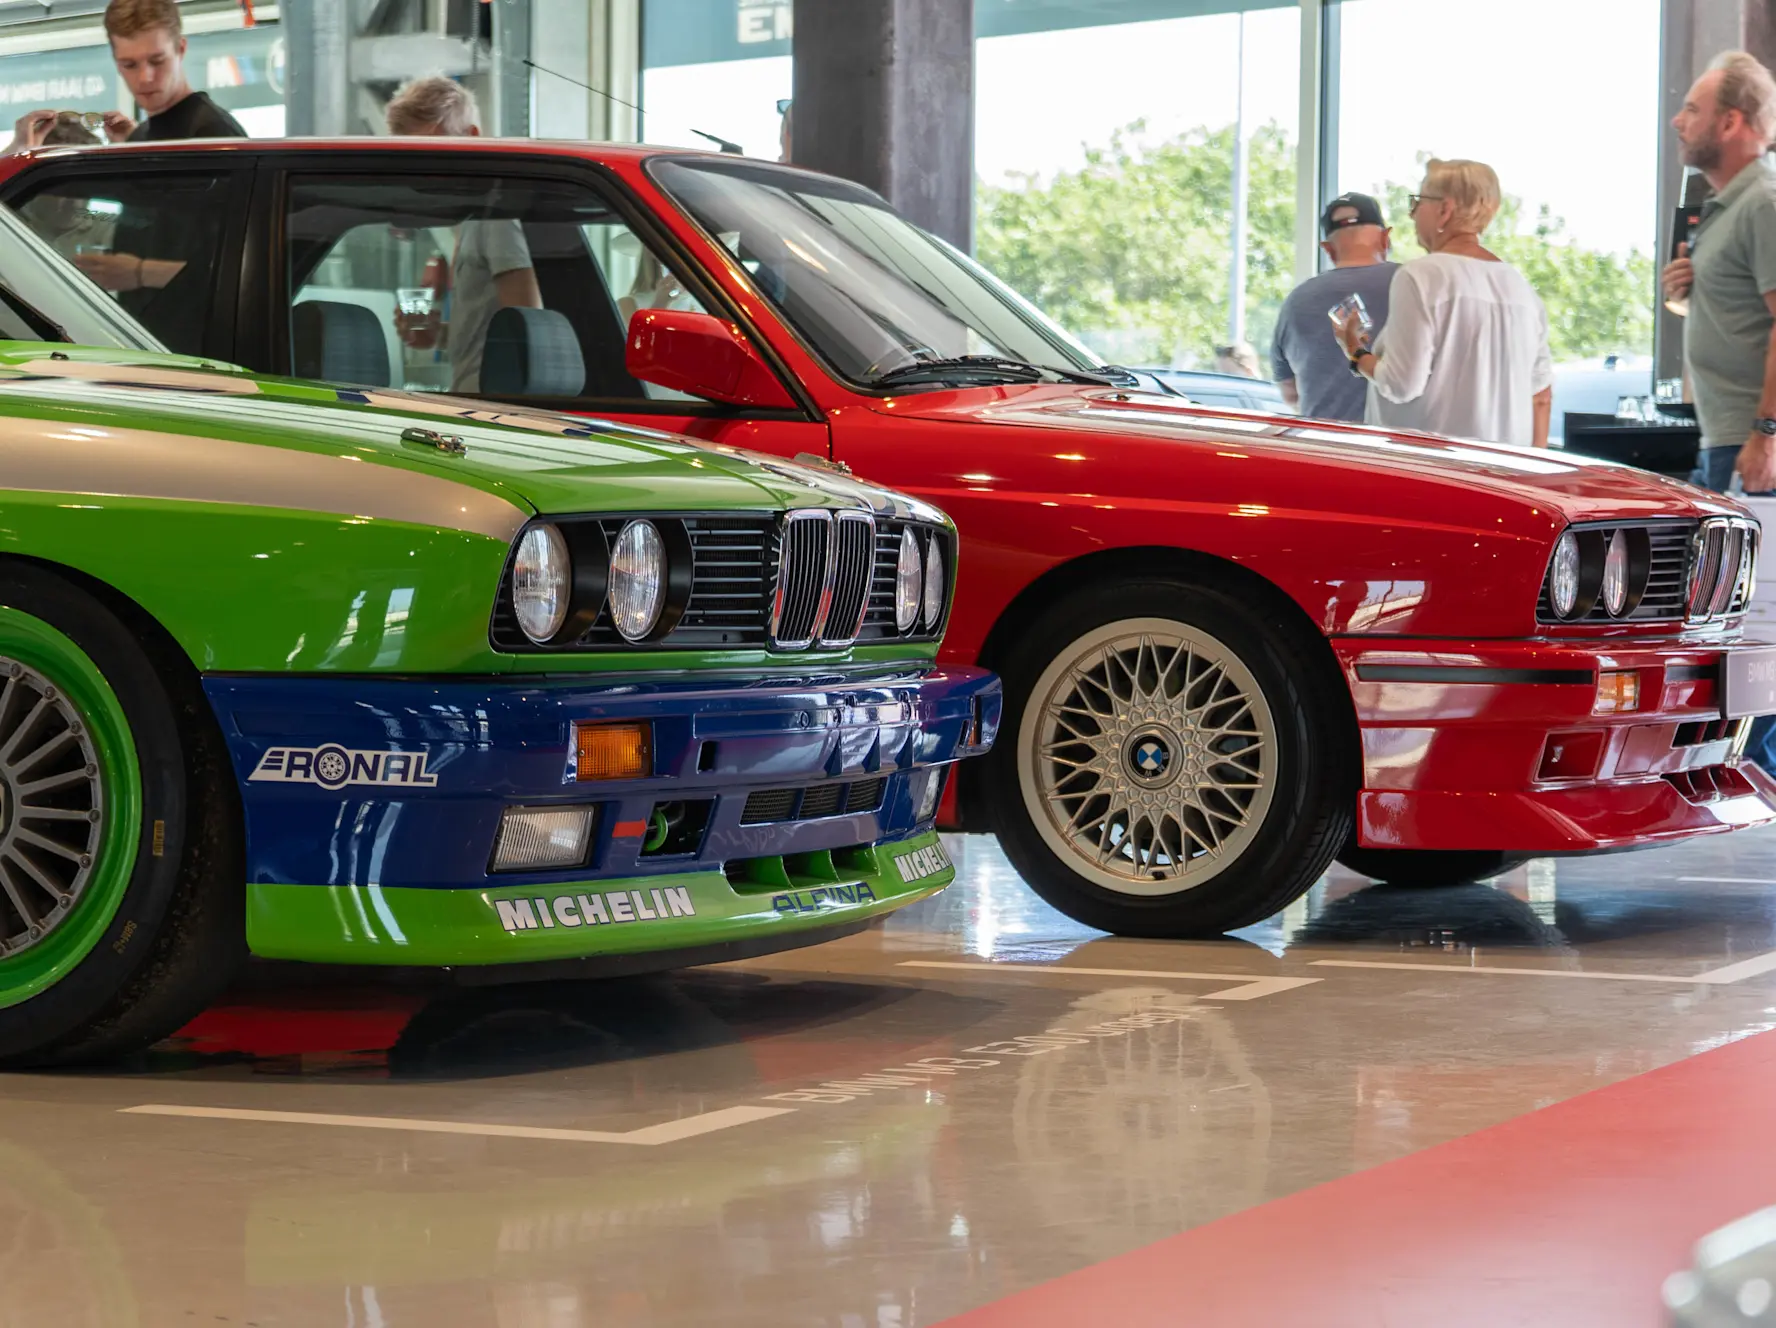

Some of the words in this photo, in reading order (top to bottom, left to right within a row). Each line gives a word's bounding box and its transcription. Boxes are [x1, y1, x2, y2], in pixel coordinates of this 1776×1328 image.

[285, 747, 435, 785] RONAL
[494, 885, 697, 931] MICHELIN
[772, 881, 877, 914] ALPINA
